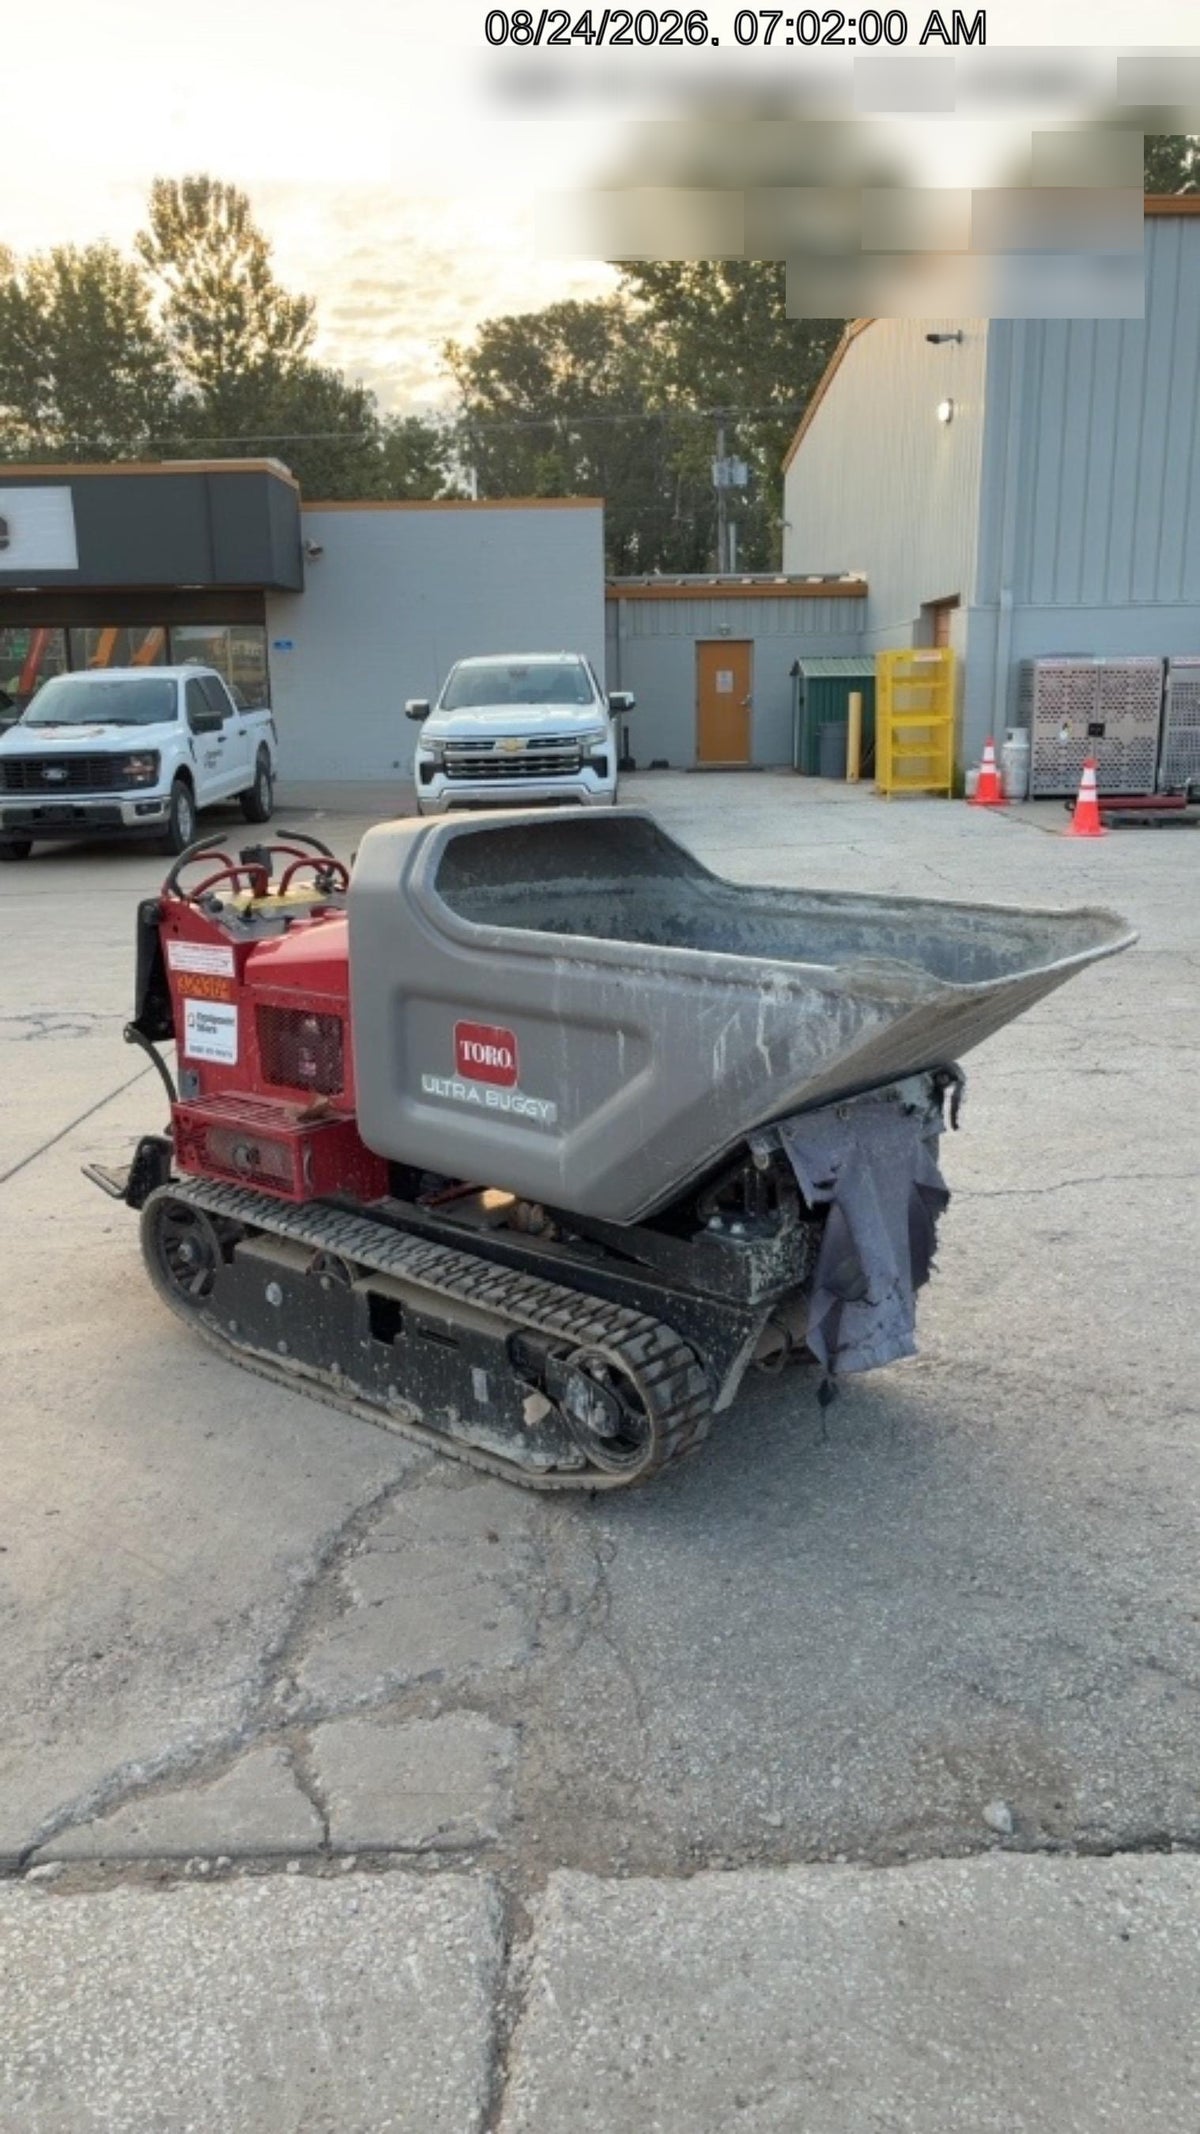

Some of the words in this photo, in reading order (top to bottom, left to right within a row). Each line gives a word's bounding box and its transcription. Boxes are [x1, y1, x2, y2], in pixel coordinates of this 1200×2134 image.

[460, 1040, 511, 1068] TORO
[422, 1074, 481, 1102] ULTRA
[485, 1090, 550, 1118] BUGGY
